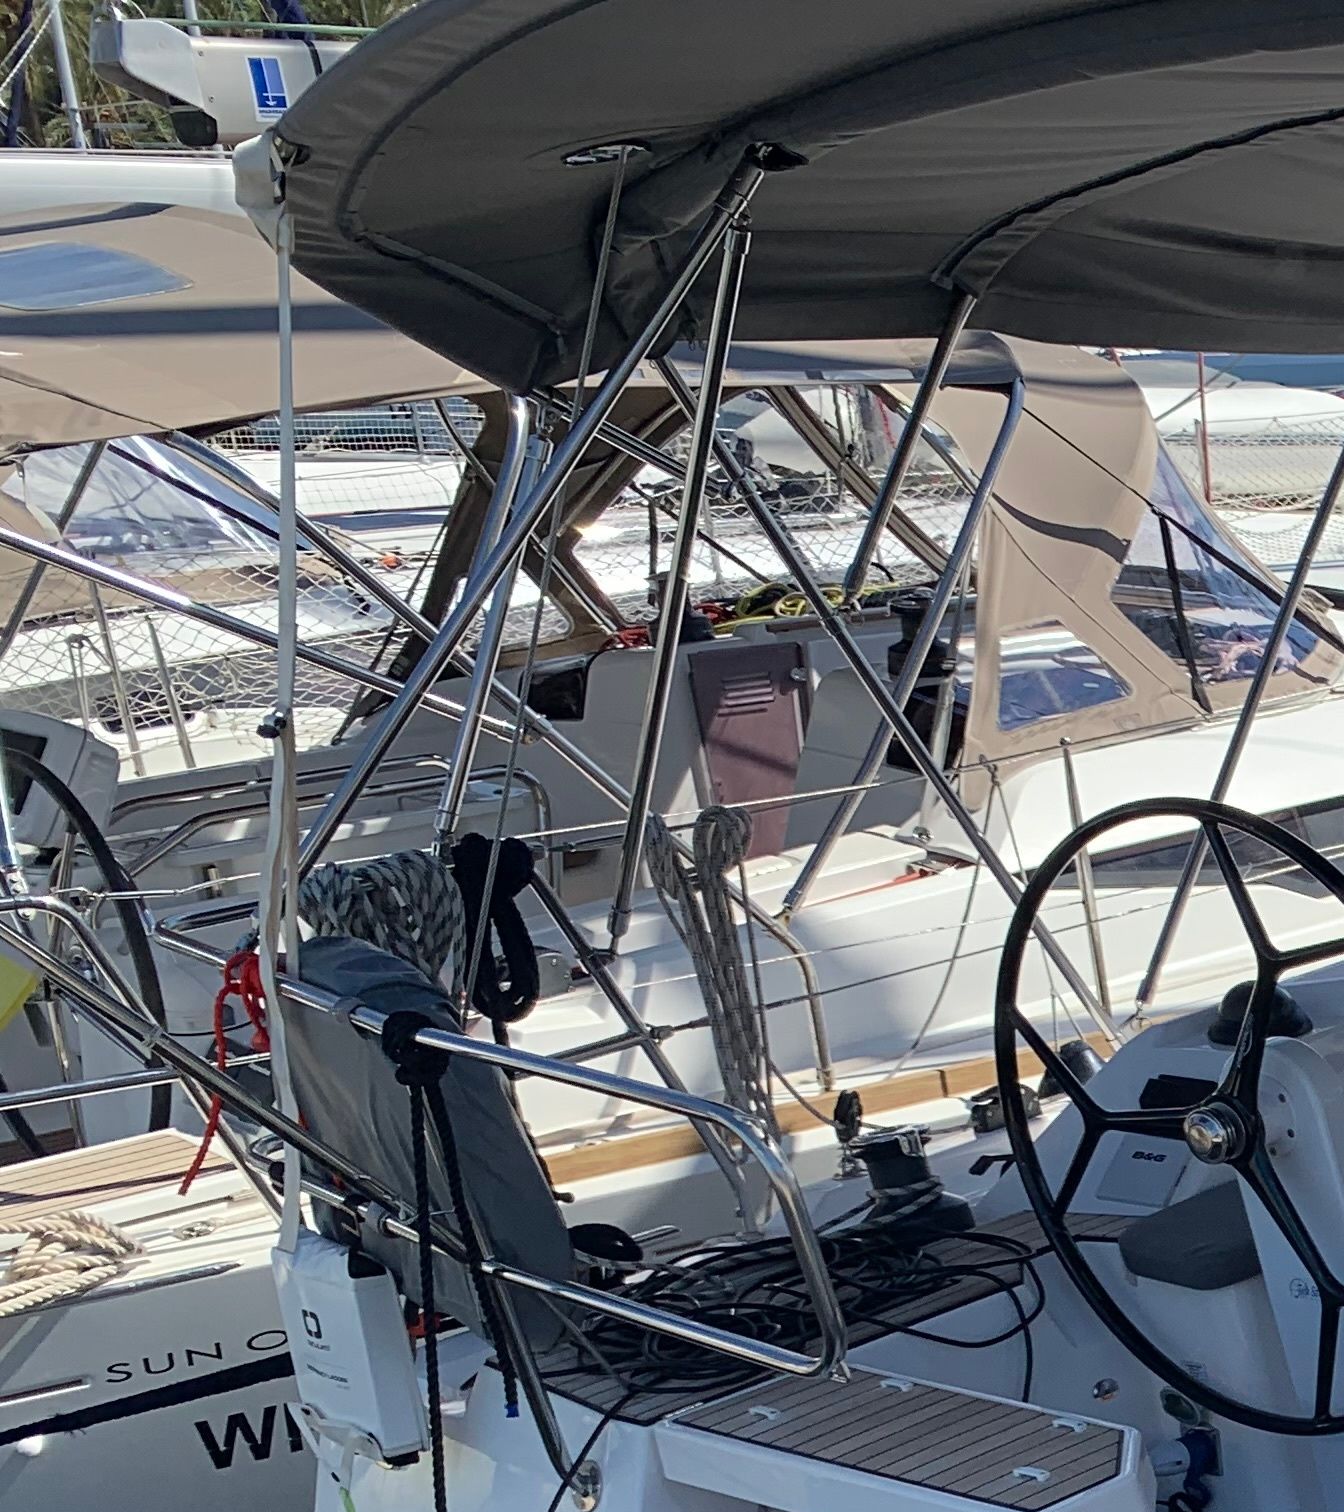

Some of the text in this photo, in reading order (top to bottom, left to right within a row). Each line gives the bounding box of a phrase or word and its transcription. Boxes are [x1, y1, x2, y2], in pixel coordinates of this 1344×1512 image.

[105, 1342, 223, 1383] SUN
[247, 1329, 288, 1350] O
[194, 1402, 304, 1470] WI
